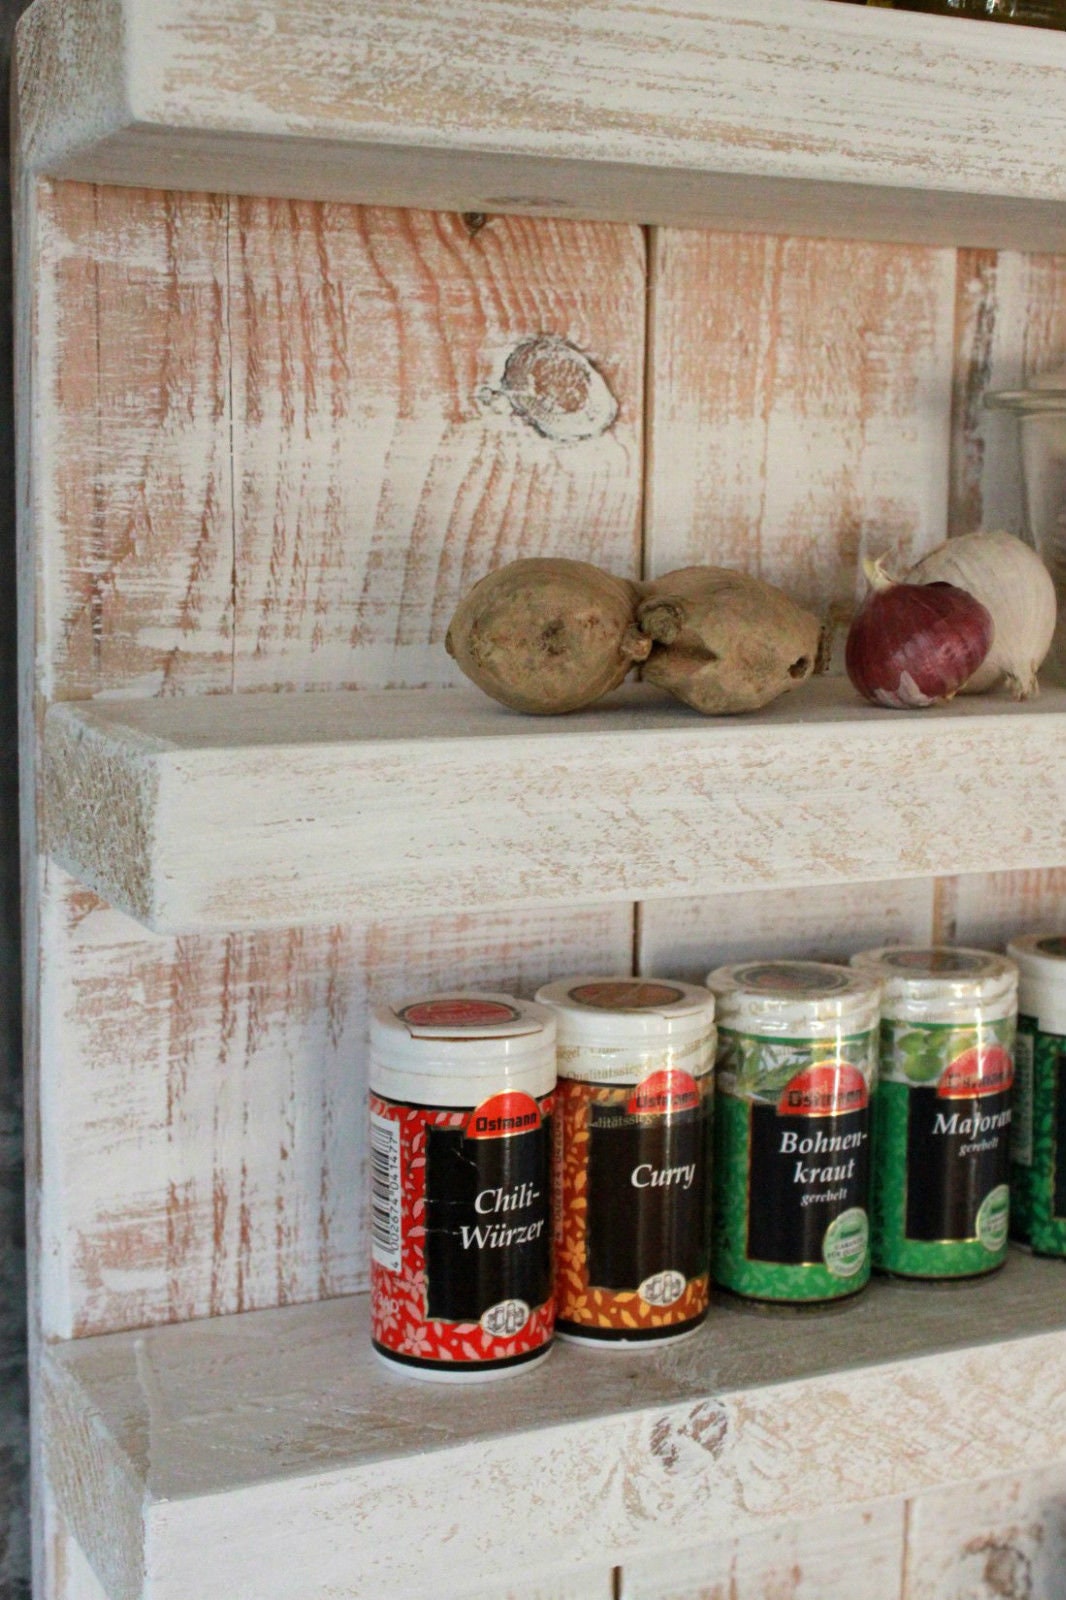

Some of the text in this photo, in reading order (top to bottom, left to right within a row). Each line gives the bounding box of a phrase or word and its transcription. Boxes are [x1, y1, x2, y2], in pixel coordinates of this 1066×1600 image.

[475, 1111, 537, 1132] Ostmann
[931, 1108, 1012, 1141] Majoran
[779, 1130, 868, 1154] Bohnen-
[630, 1162, 696, 1190] Curry
[793, 1158, 856, 1184] kraut
[474, 1181, 540, 1214] Chili-
[459, 1218, 545, 1250] Würzer
